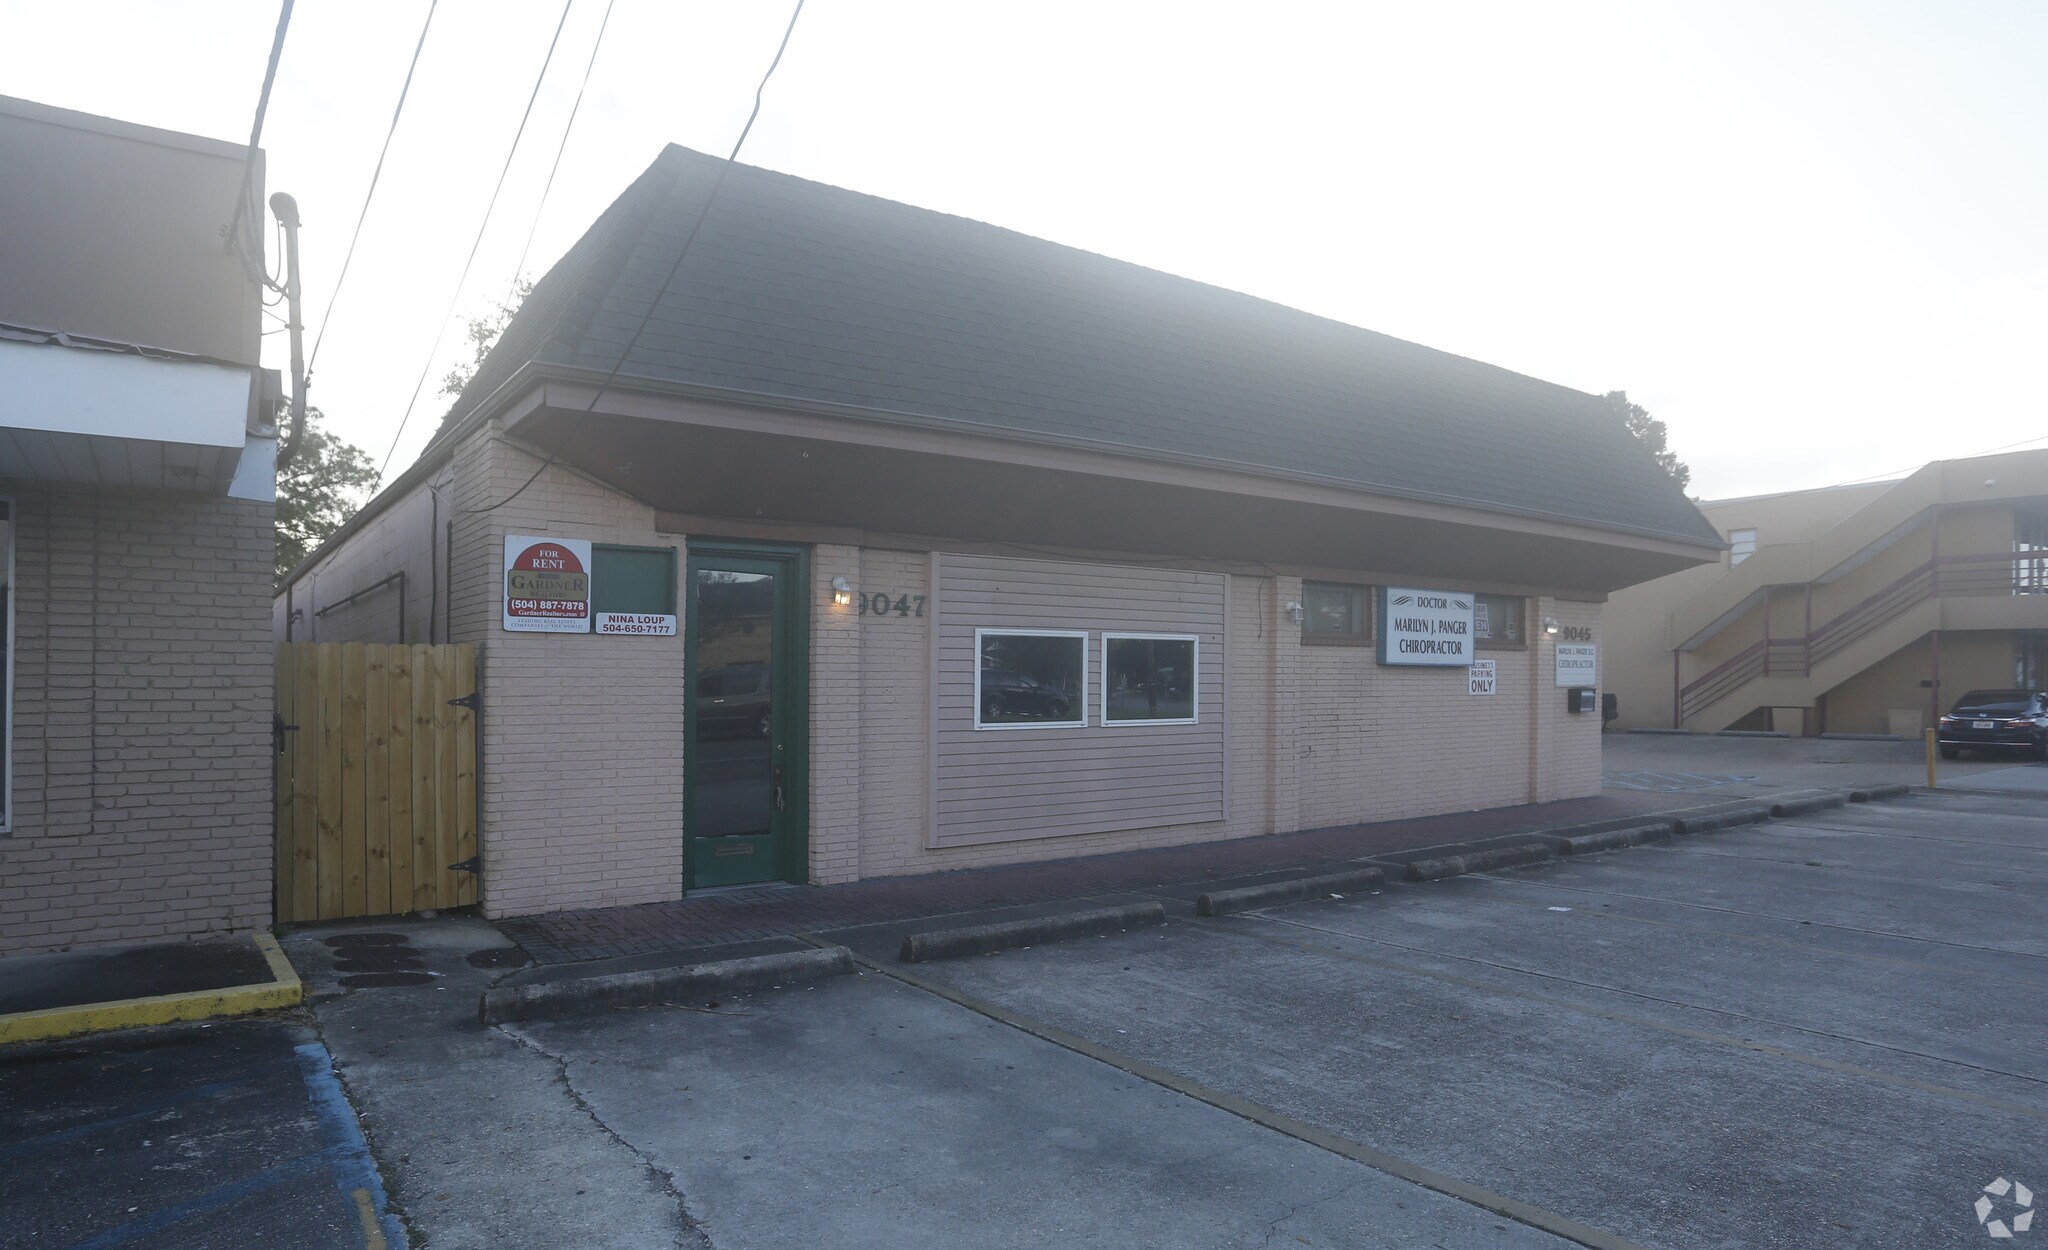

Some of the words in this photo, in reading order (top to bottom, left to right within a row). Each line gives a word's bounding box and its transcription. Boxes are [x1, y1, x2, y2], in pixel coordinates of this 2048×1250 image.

[540, 550, 558, 558] FOR
[532, 559, 565, 569] RENT
[511, 575, 584, 591] GARDNER
[511, 599, 537, 609] (504)
[540, 601, 584, 610] 887-7878
[1417, 597, 1447, 609] DOCTOR
[608, 615, 634, 623] NINA
[637, 616, 665, 624] LOUP
[602, 624, 670, 633] 504-650-7177
[1394, 617, 1428, 632] MARILYN
[1431, 620, 1436, 636] J.
[1439, 620, 1467, 635] PANGER
[1563, 626, 1591, 641] 9045
[1399, 638, 1462, 655] CHIROPRACTOR
[1471, 670, 1493, 678] PARKING
[1471, 680, 1493, 693] ONLY
